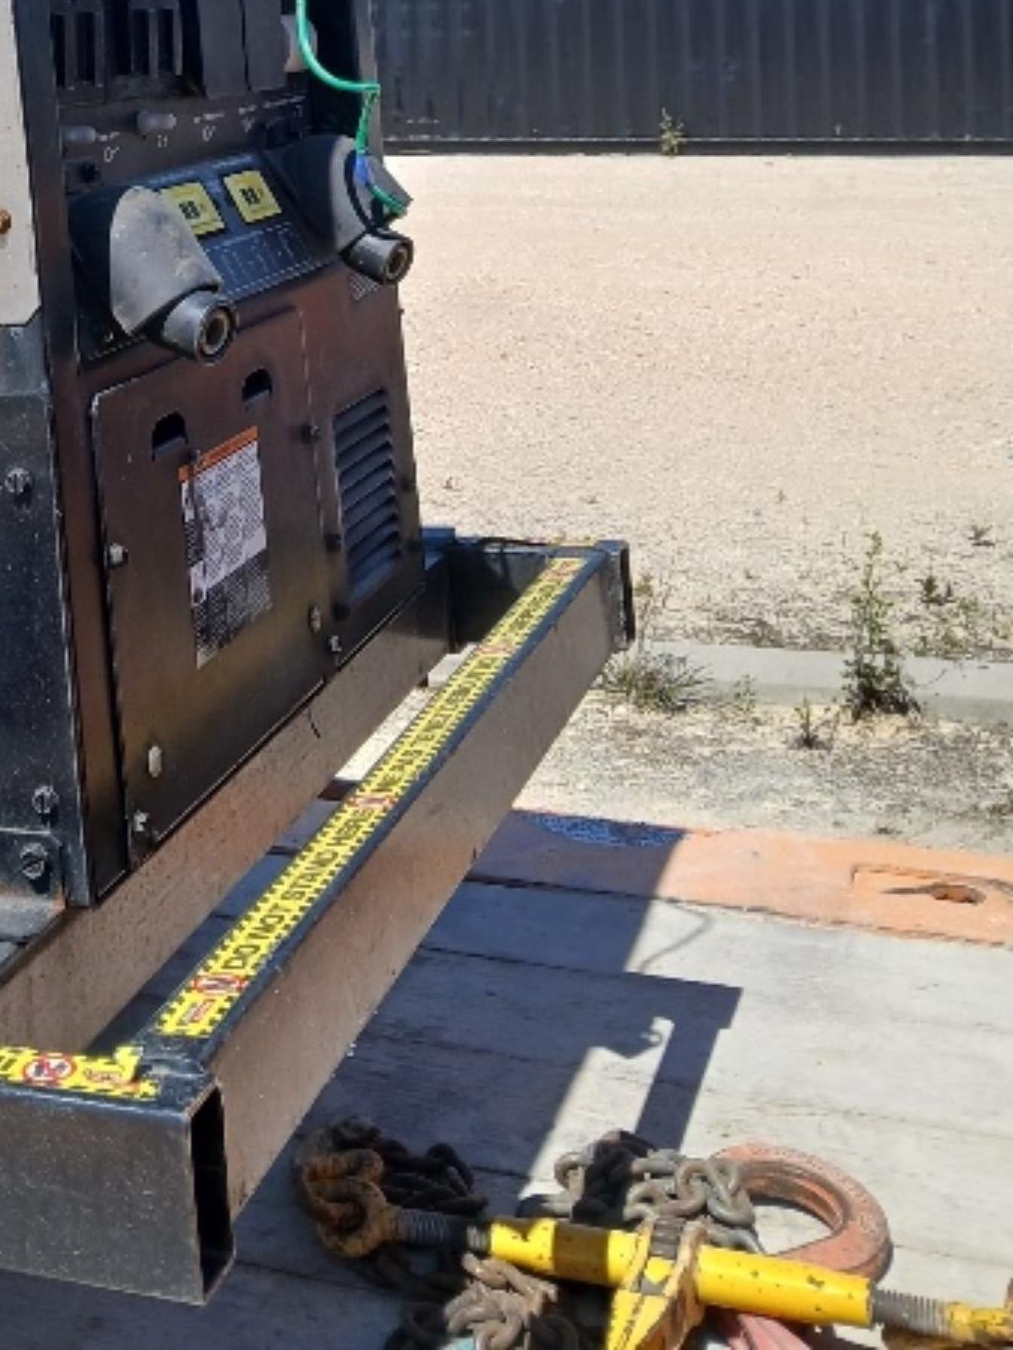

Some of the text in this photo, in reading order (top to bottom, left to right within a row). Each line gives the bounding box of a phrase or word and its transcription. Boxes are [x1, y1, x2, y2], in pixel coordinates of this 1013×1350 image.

[221, 808, 375, 970] DO NOT STAND HERE
